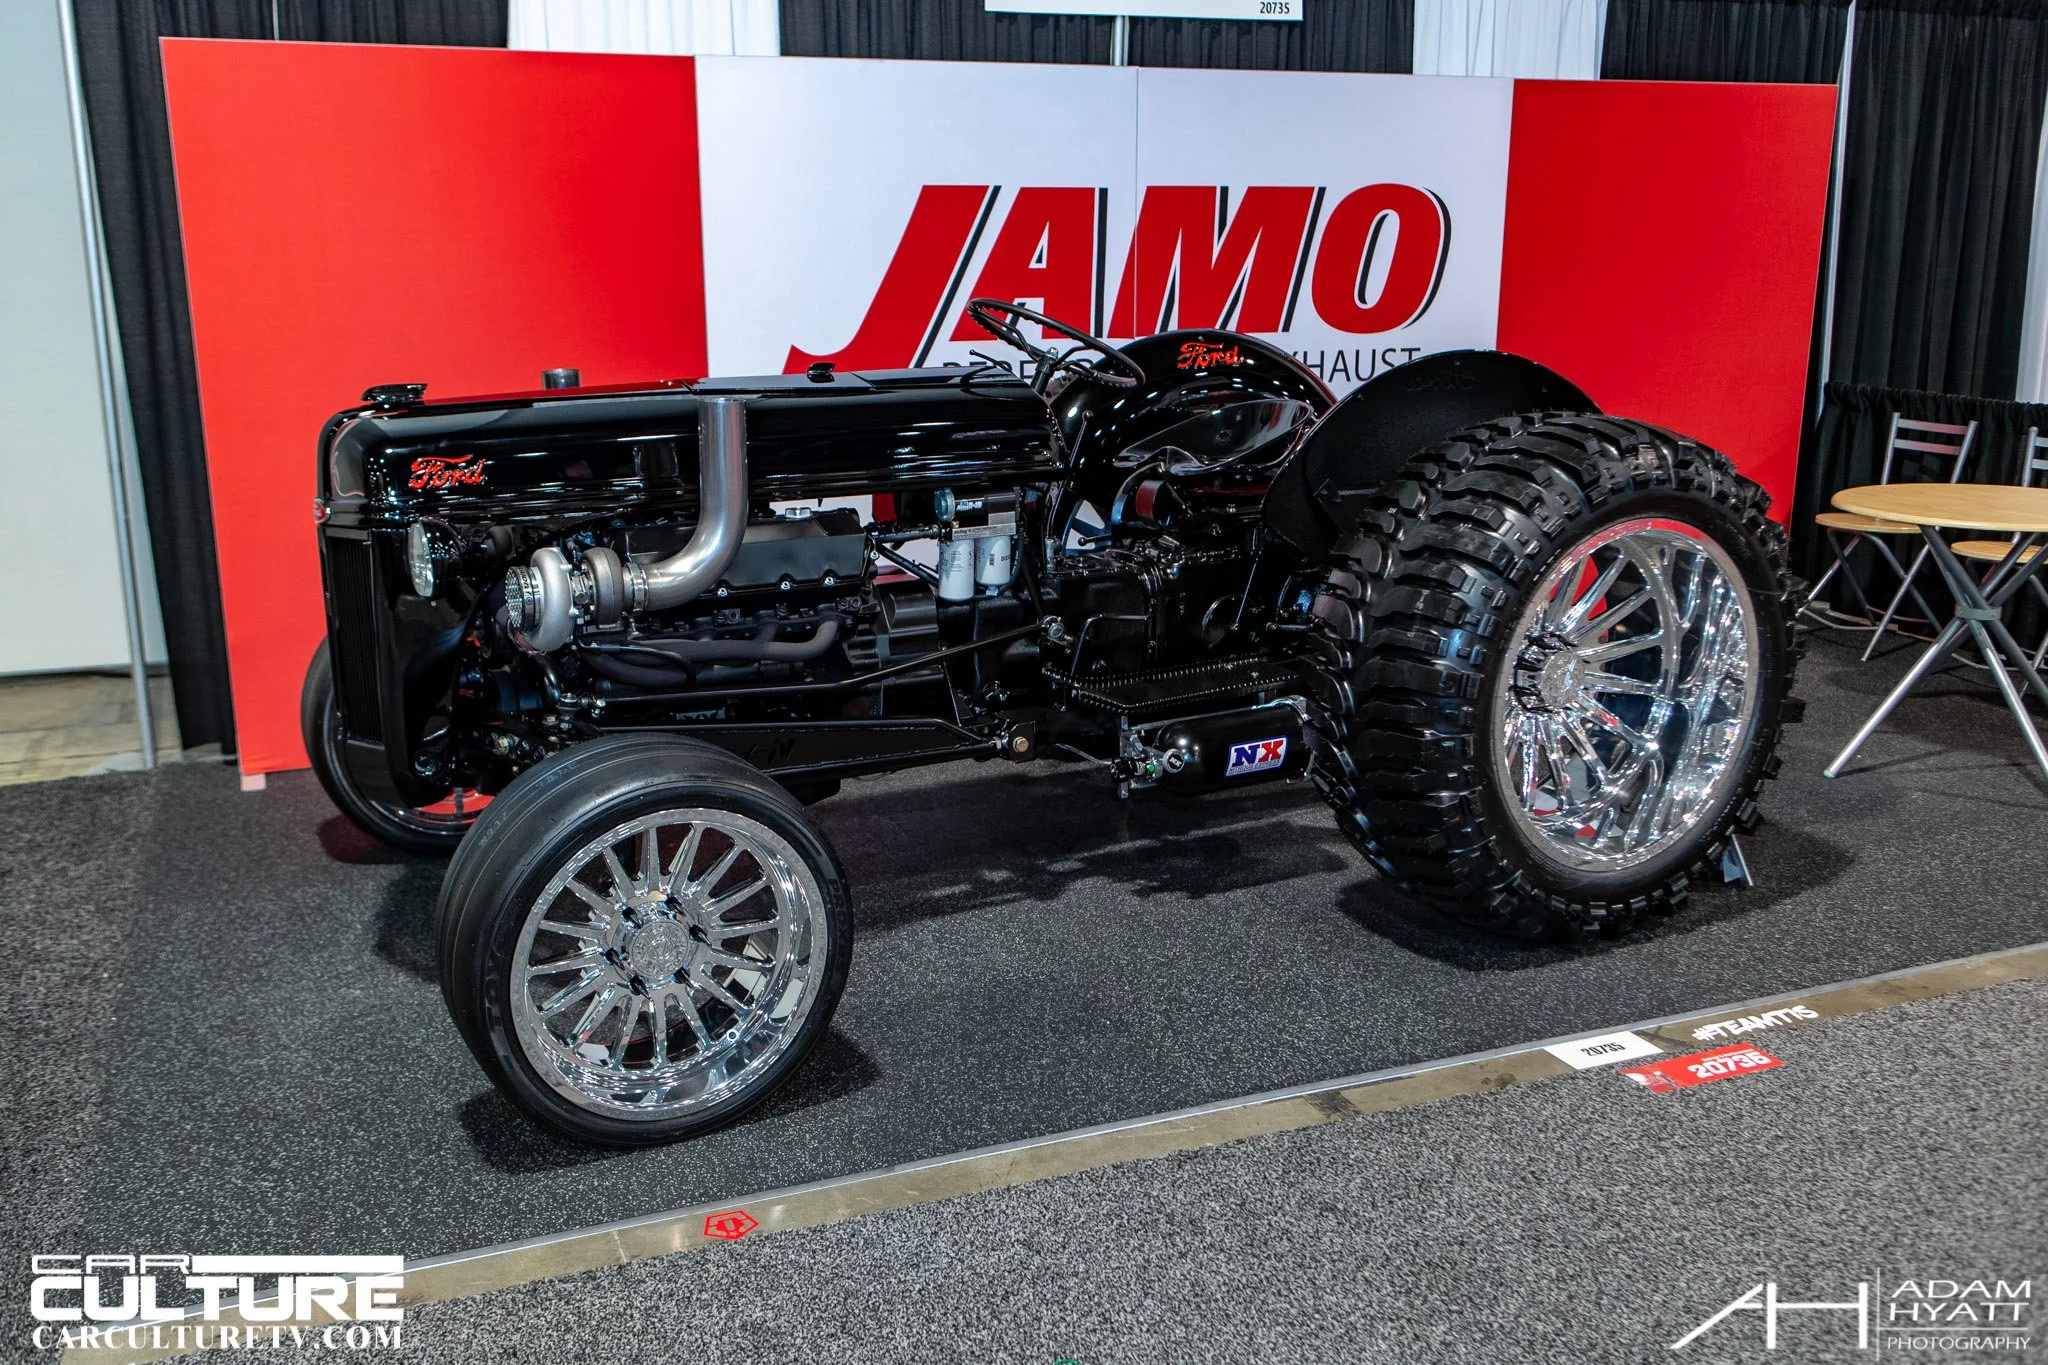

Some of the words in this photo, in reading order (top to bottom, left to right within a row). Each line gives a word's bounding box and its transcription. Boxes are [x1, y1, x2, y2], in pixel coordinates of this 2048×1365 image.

[1260, 1, 1290, 14] 20735
[783, 183, 1451, 374] JAMO
[1177, 341, 1244, 369] Ford
[408, 454, 486, 490] Ford
[1232, 740, 1284, 767] NX
[565, 821, 645, 876] FORGED
[1691, 1005, 1819, 1042] #TEAMTIS
[1581, 1041, 1625, 1057] 20735
